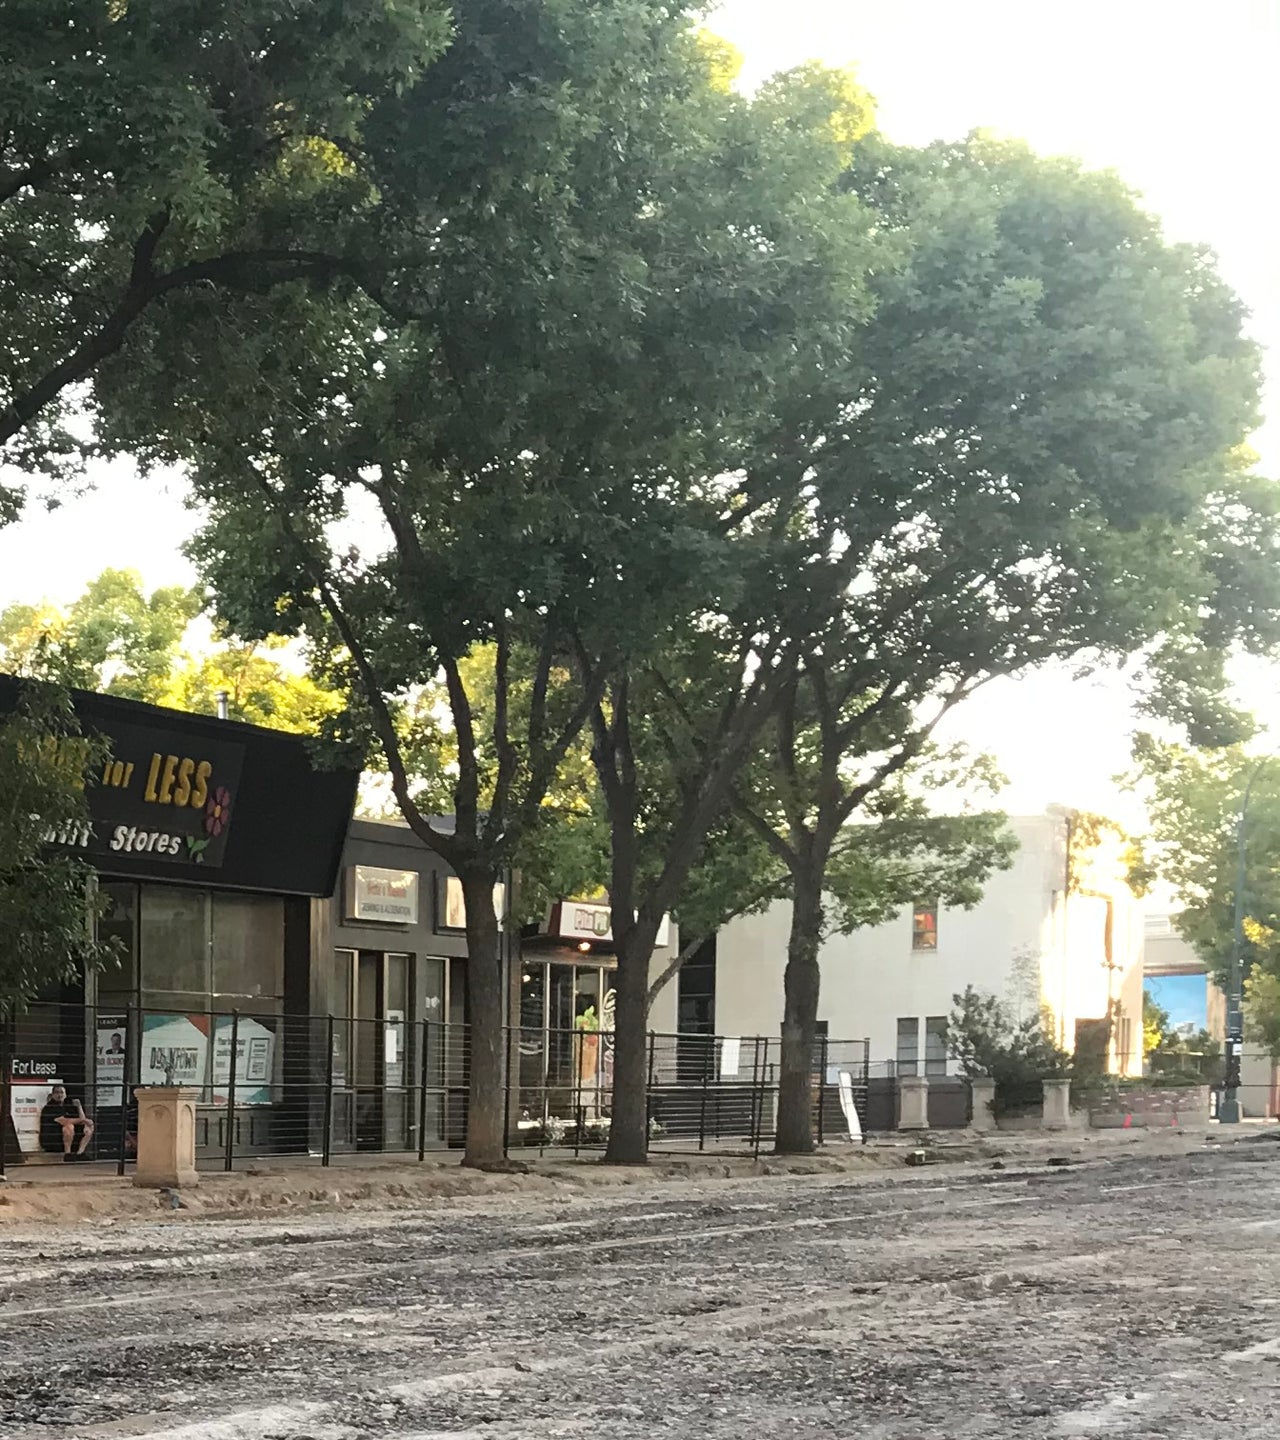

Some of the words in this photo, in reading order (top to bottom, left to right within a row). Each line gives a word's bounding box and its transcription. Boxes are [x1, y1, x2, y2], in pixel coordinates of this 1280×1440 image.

[144, 752, 212, 809] LESS
[110, 825, 182, 855] Stores
[12, 1059, 29, 1075] For
[30, 1059, 57, 1075] Lease
